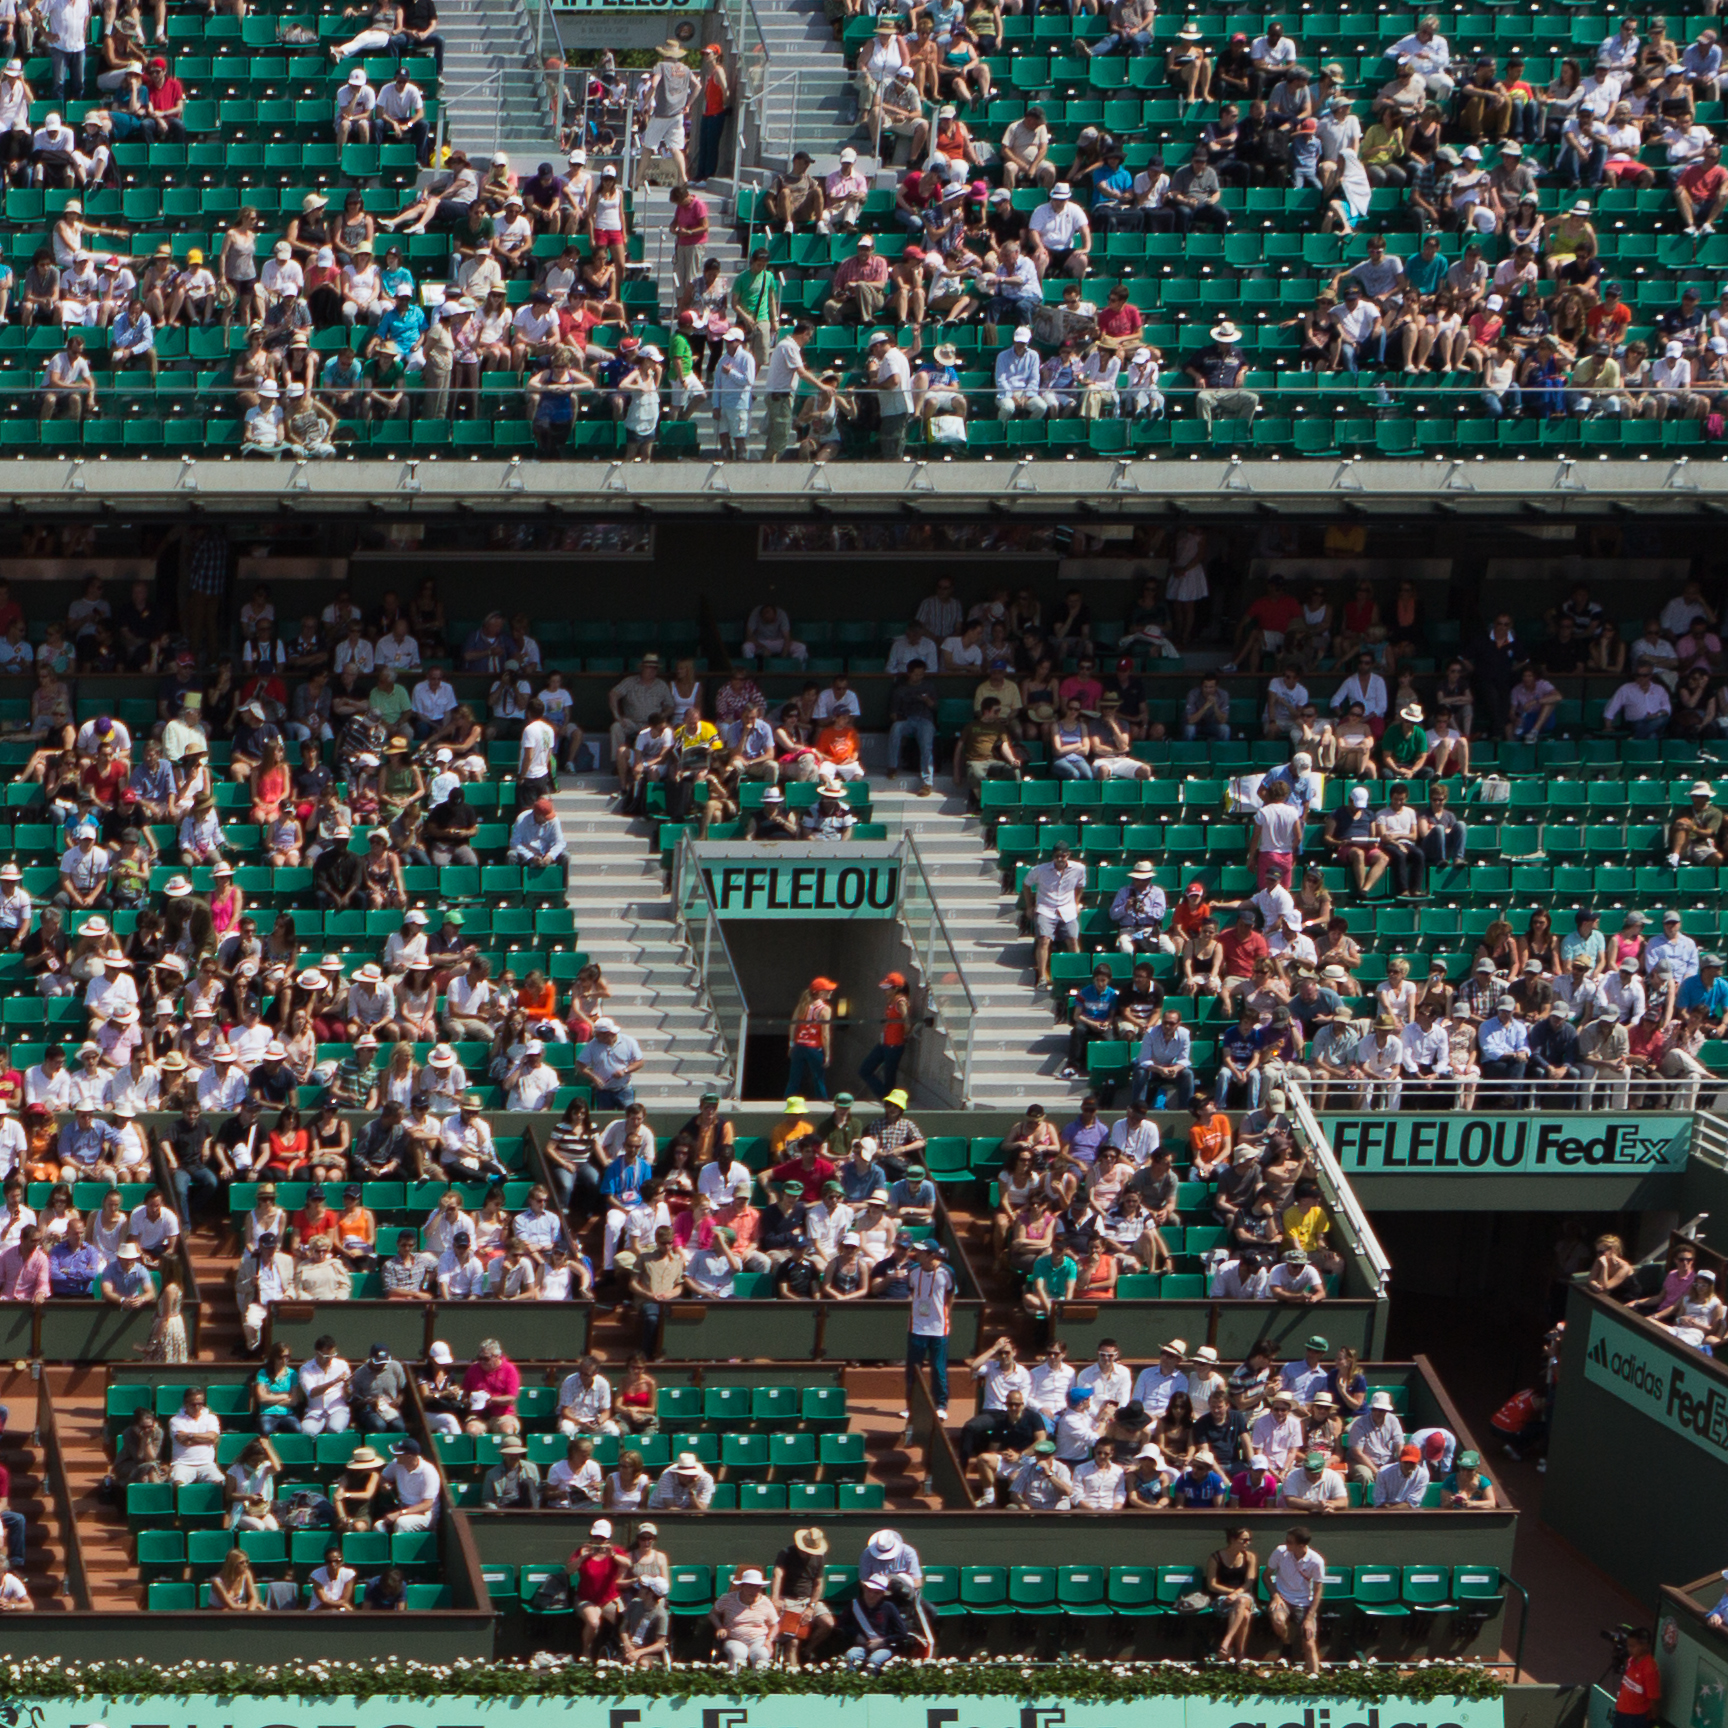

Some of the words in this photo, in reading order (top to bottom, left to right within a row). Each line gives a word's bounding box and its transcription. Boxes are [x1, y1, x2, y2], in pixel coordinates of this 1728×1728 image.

[1318, 1121, 1527, 1167] FFLELOU
[1536, 1123, 1671, 1166] FedEx
[1611, 1352, 1663, 1401] adidas
